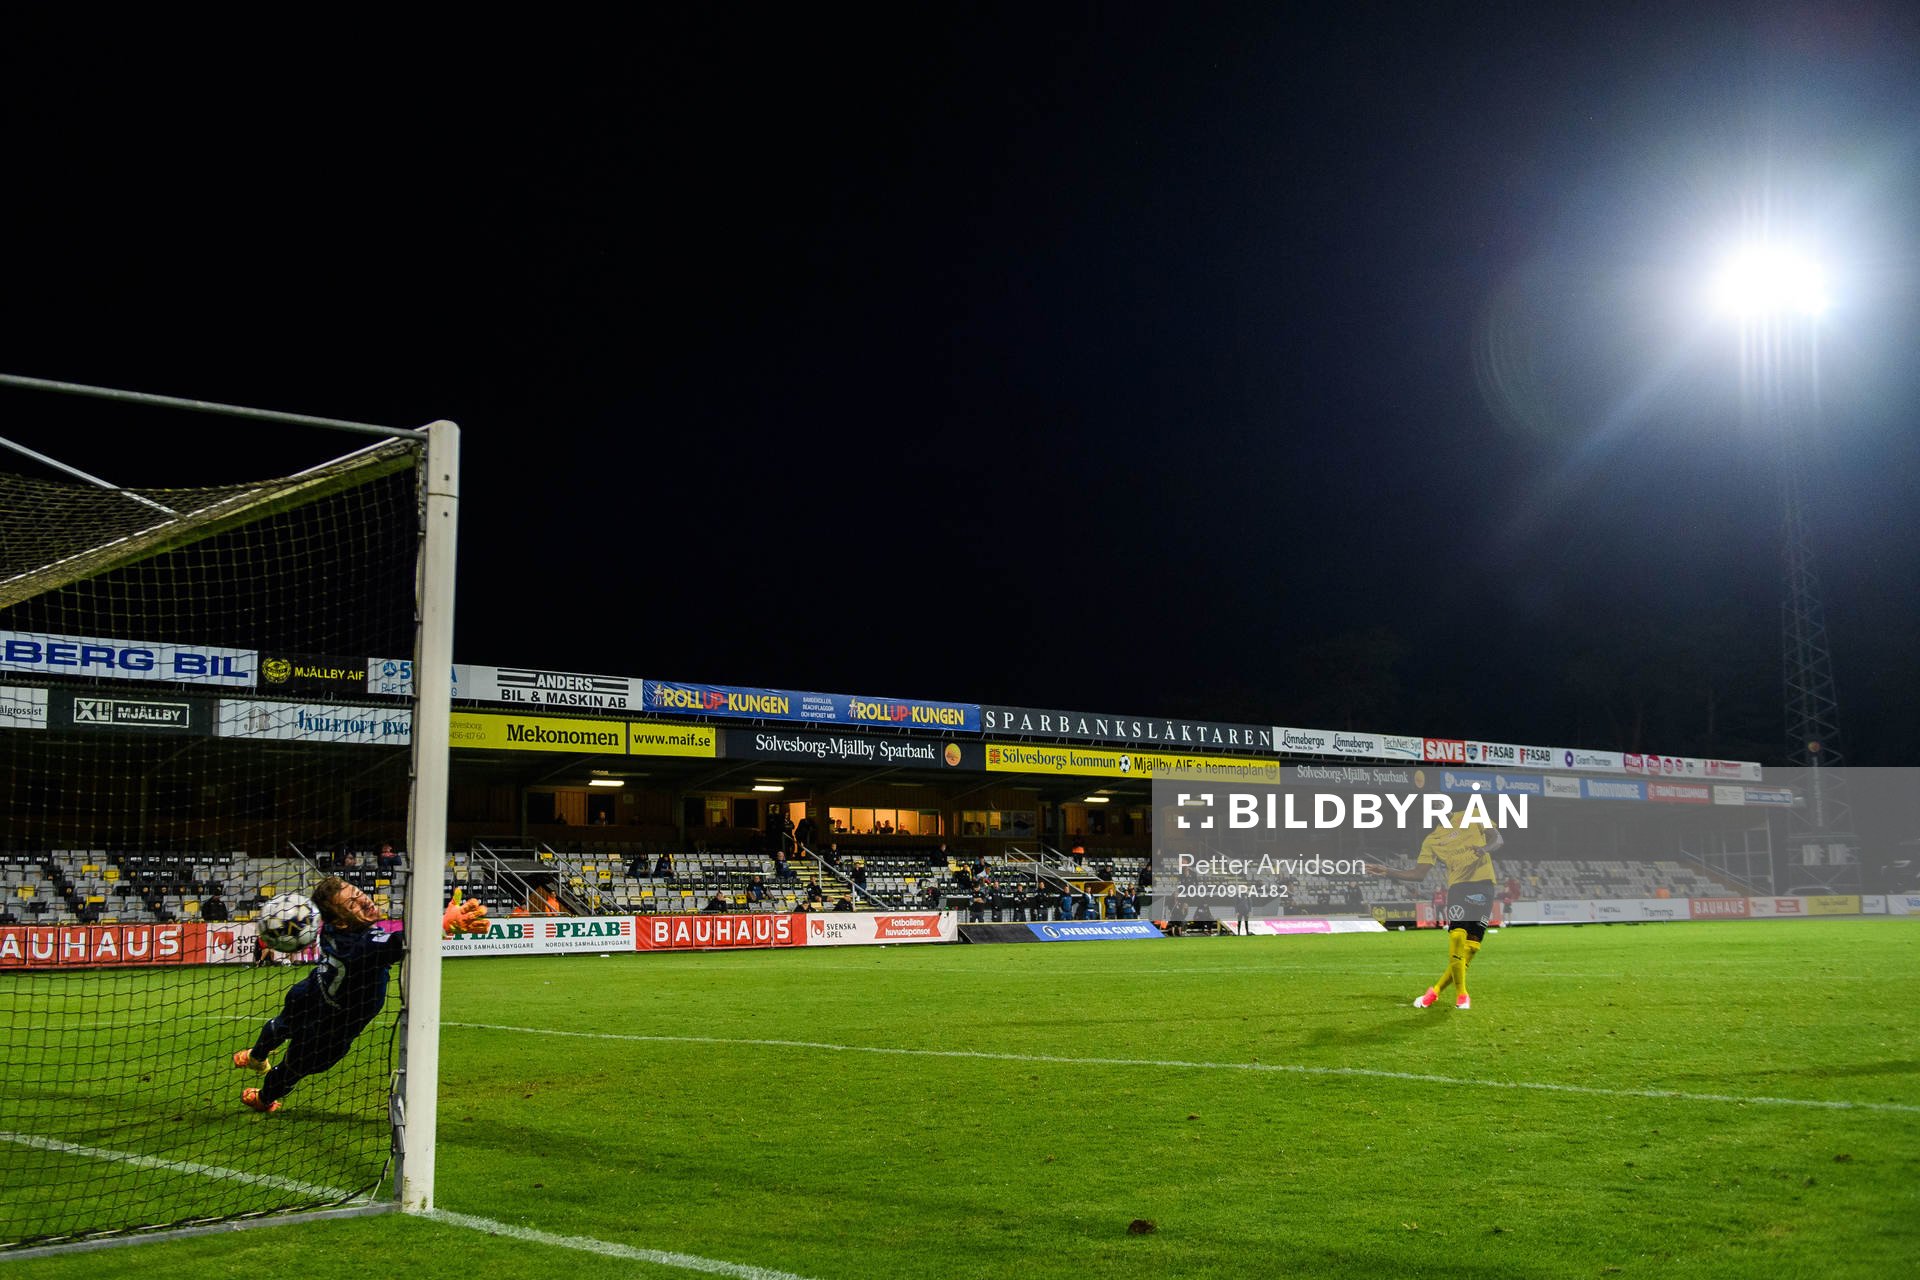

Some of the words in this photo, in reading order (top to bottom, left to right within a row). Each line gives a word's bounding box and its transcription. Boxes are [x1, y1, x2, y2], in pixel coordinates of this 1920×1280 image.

[0, 640, 154, 671] BERG
[174, 653, 248, 678] BIL
[294, 666, 345, 679] MJÄLLBY
[347, 670, 365, 680] AIF
[536, 674, 594, 691] ANDERS
[501, 689, 525, 701] BIL
[531, 691, 541, 702] &
[546, 692, 603, 706] MASKIN
[608, 697, 627, 708] AB
[118, 704, 180, 721] MJÄLLBY
[507, 724, 619, 746] Mekonomen
[986, 711, 1270, 746] SPARBANKSLÄKTAREN
[634, 734, 710, 746] www.maif.se
[755, 734, 875, 761] Sölvesborg-Mjällby
[880, 741, 935, 761] Sparbank
[1282, 730, 1325, 748] Lönneberga
[1333, 733, 1374, 751] Lönneberga
[1002, 748, 1067, 770] Sölvesborgs
[1070, 752, 1116, 768] kommun
[1426, 741, 1464, 760] SAVE
[1489, 746, 1514, 758] FASAB
[1526, 749, 1551, 761] FASAB
[1134, 757, 1172, 775] Mjällby
[1205, 761, 1263, 778] hemmaplan
[1297, 764, 1370, 784] Sölvesborg-Mjällby
[1374, 769, 1408, 785] Sparbank
[1694, 901, 1742, 914] BAUHAUS
[556, 921, 621, 938] PEAB
[655, 919, 790, 942] BAUHAUS
[827, 923, 857, 931] SVENSKA
[1060, 926, 1112, 936] SVENSKA
[1112, 925, 1151, 934] CUPEN
[442, 943, 473, 951] NORDENS
[474, 942, 534, 950] SAMHÄLLSBYGGARE
